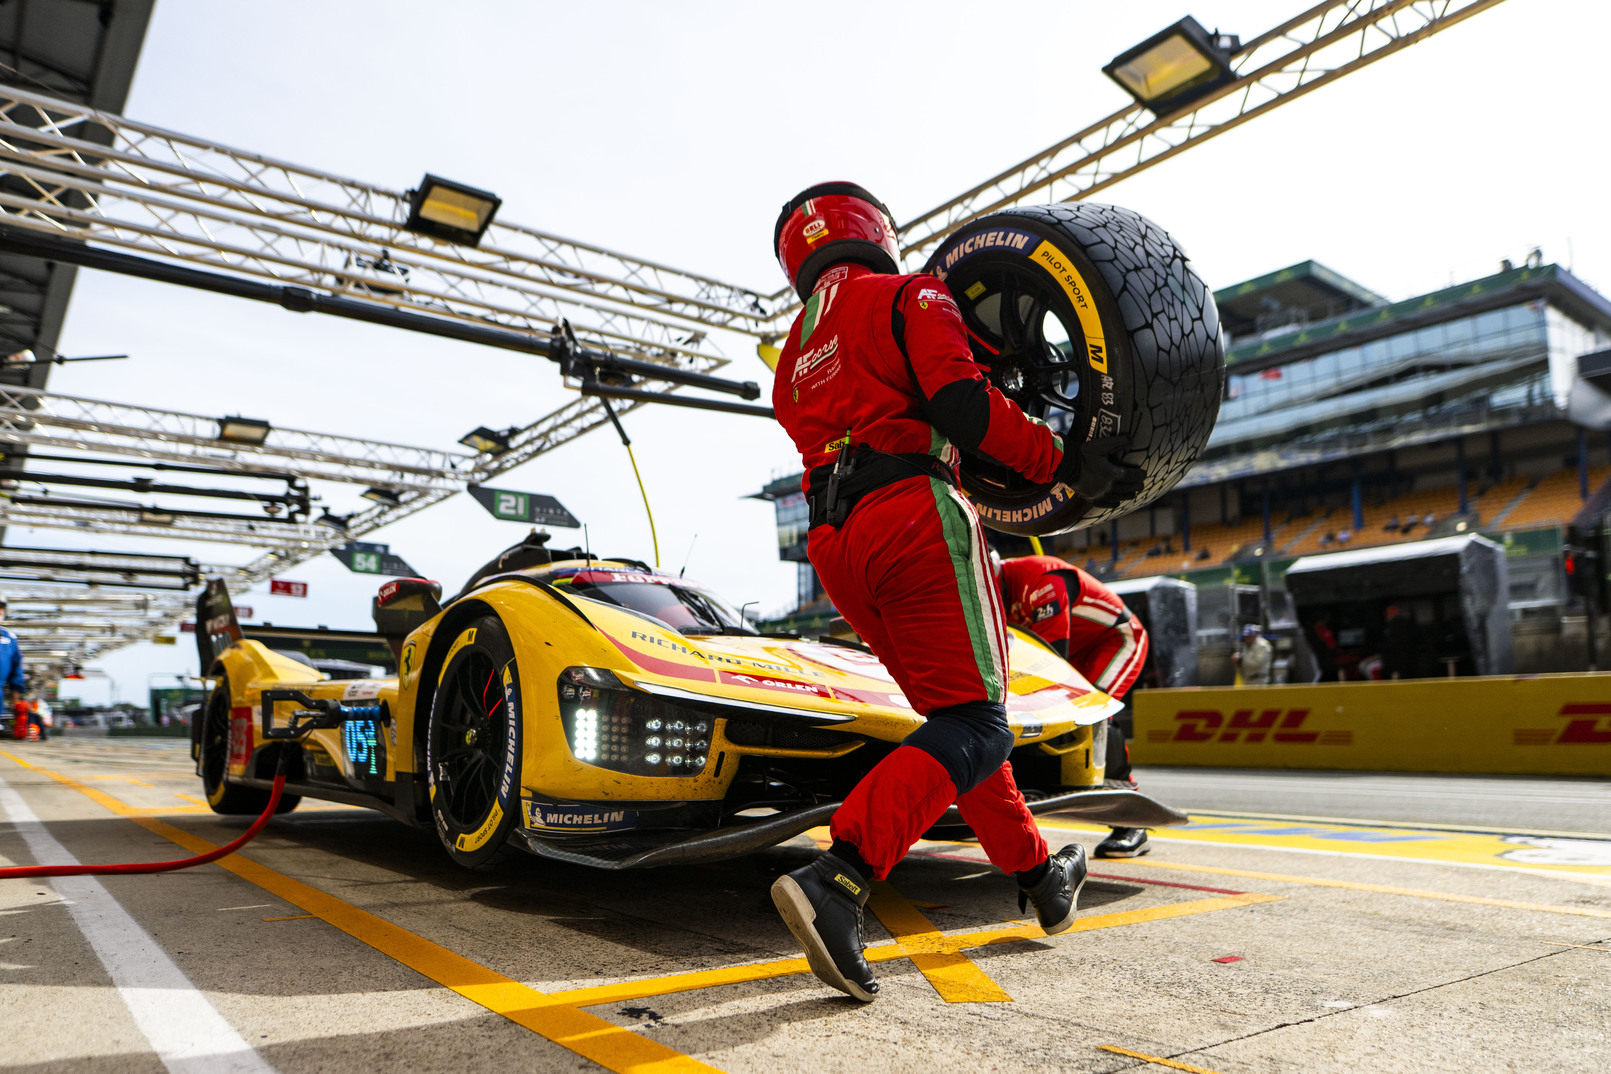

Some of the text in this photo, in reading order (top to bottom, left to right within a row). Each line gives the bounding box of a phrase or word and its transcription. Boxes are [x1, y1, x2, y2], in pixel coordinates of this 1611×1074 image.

[804, 222, 823, 234] BELL
[945, 231, 1029, 269] MICHELIN
[1041, 251, 1089, 310] PILOT SPORT
[1089, 343, 1104, 365] M
[498, 494, 525, 516] 21
[975, 497, 1053, 523] MICHELIN
[354, 553, 377, 572] 54
[631, 631, 826, 679] RICHARD MILLE
[761, 679, 819, 693] ORLEN
[1171, 708, 1320, 744] DHL
[500, 702, 517, 799] MICHELIN
[546, 810, 625, 825] MICHELIN
[837, 875, 859, 893] Sabelt
